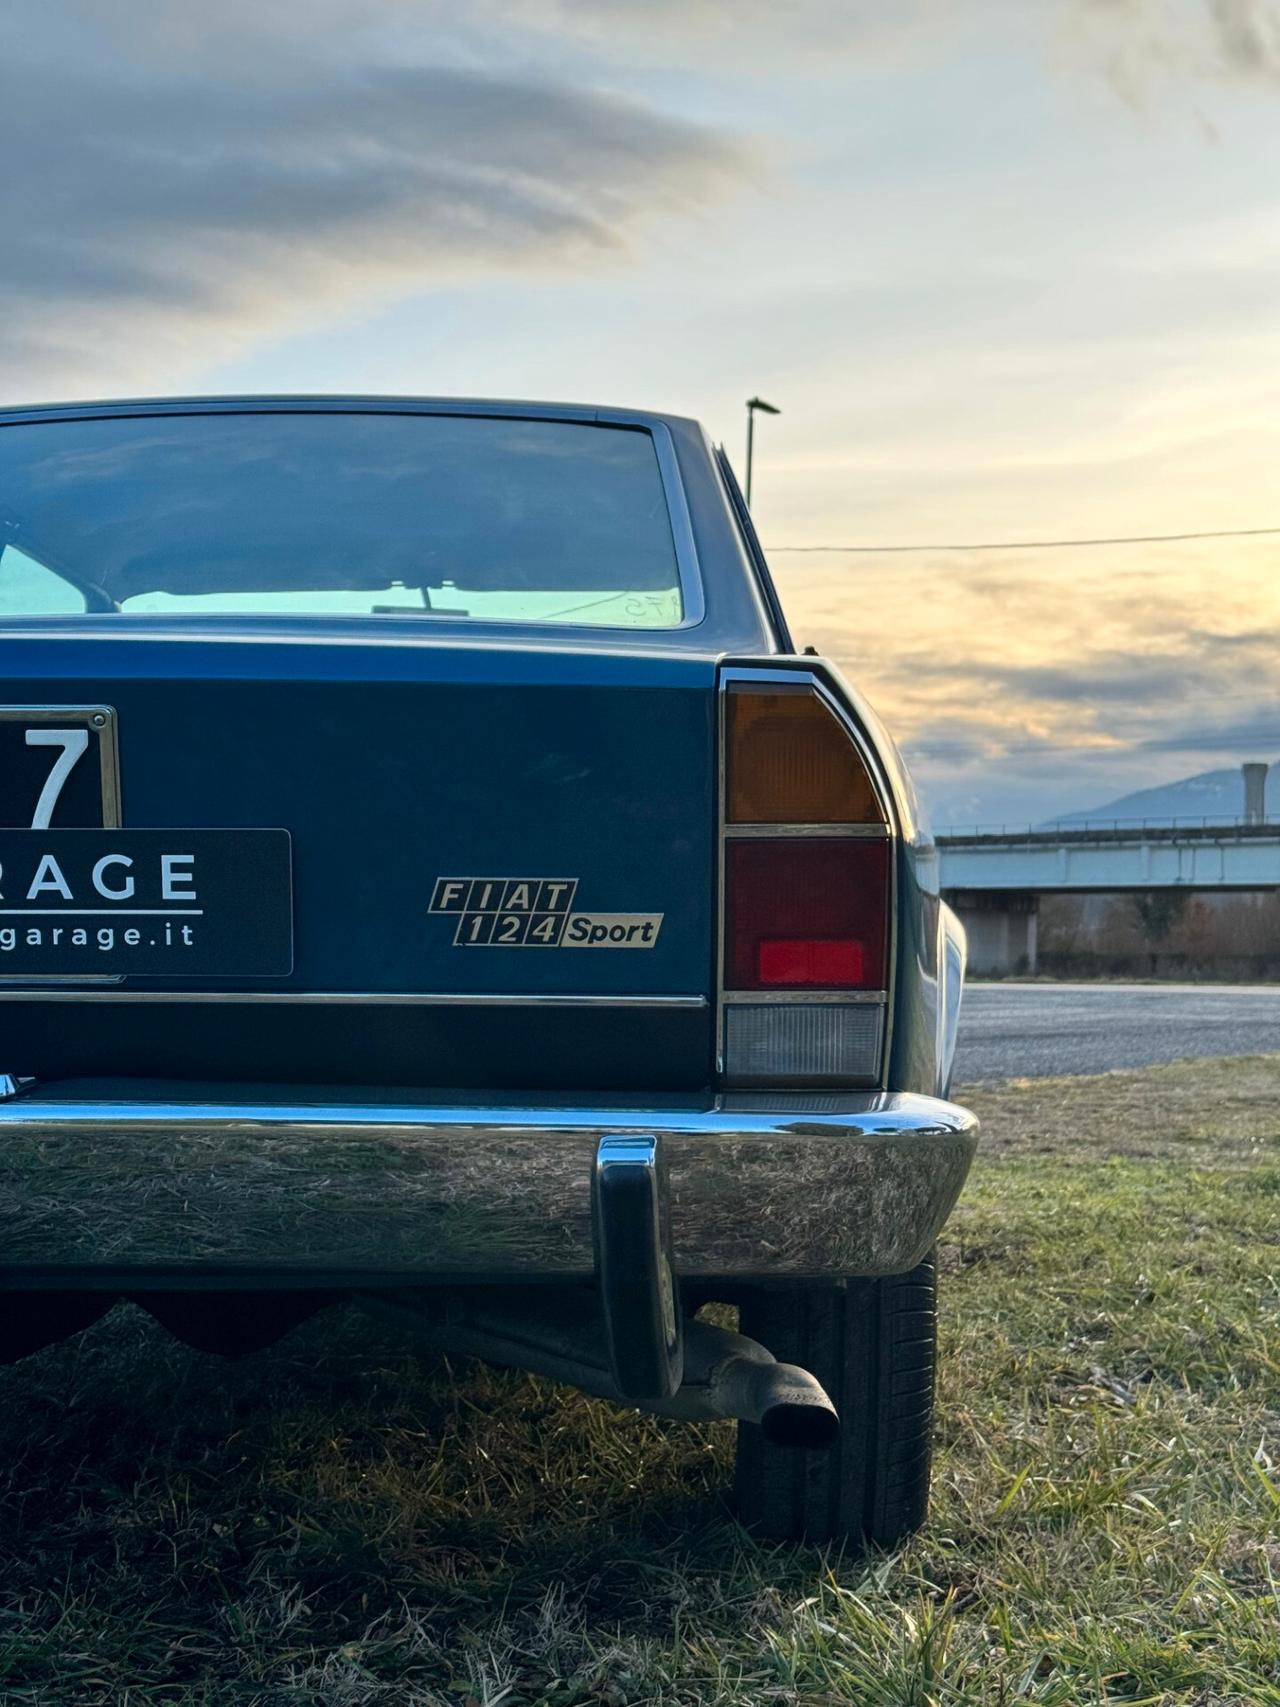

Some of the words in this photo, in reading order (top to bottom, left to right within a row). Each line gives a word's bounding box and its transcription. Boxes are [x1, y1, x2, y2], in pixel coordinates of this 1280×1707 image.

[25, 729, 89, 830] 7
[0, 854, 197, 900] AGE
[439, 883, 568, 909] FIAT
[0, 922, 194, 950] garage.it
[470, 915, 556, 942] 124
[567, 917, 654, 943] Sport
